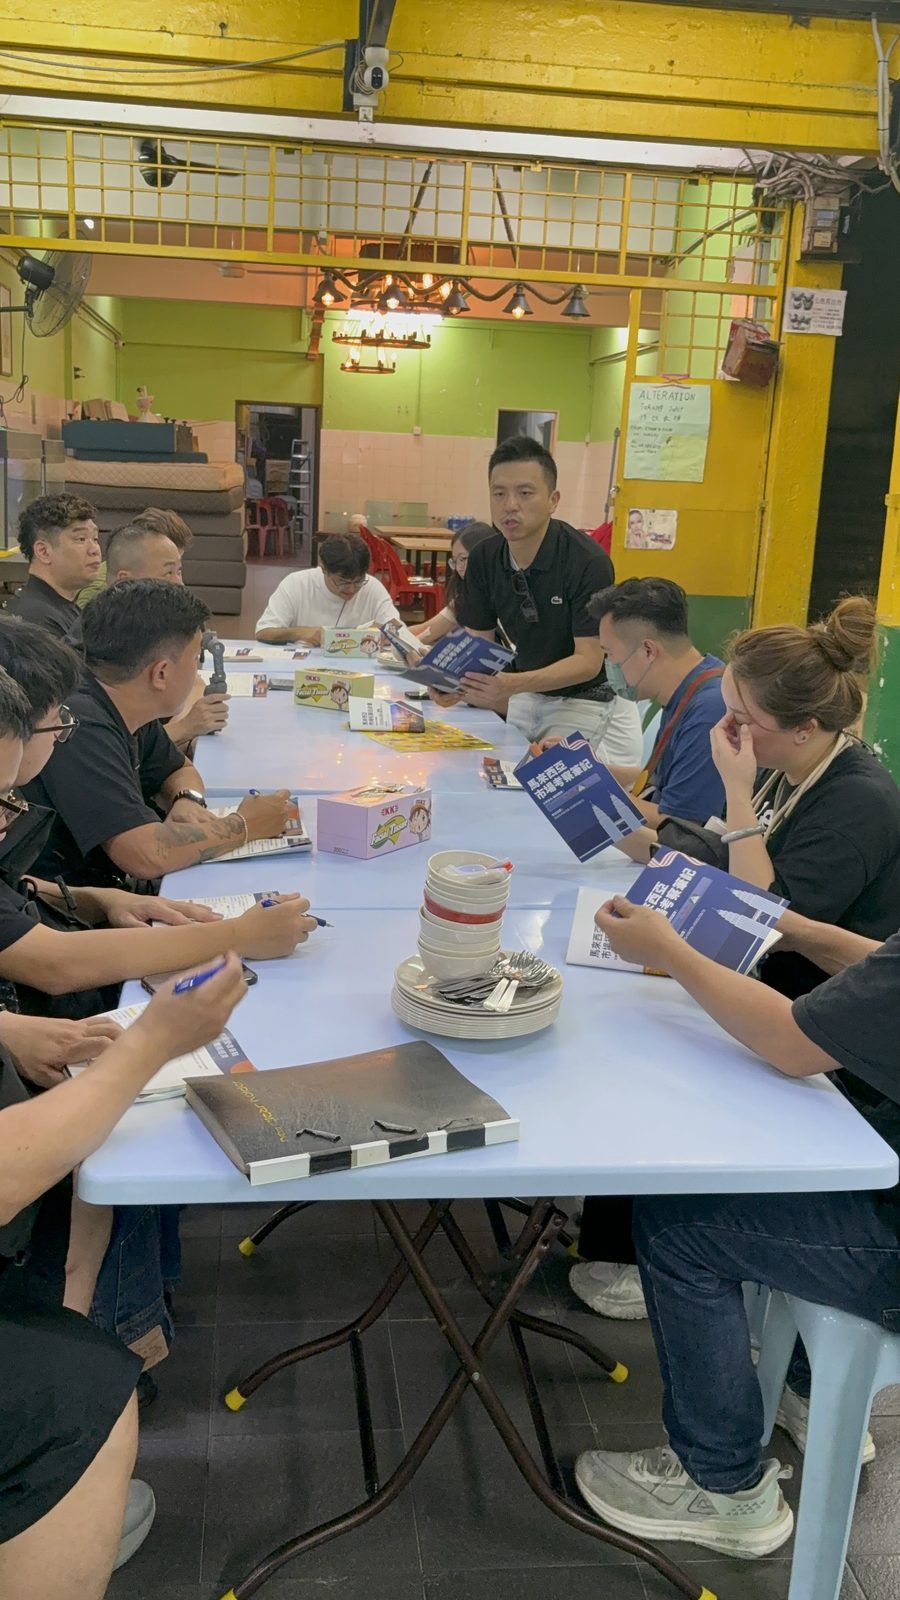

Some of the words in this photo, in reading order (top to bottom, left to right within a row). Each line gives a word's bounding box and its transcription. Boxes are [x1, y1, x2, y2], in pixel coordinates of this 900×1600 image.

[639, 390, 696, 401] ALTERATION
[527, 760, 568, 791] 馬來西亞
[534, 758, 593, 800] 市場考察筆記
